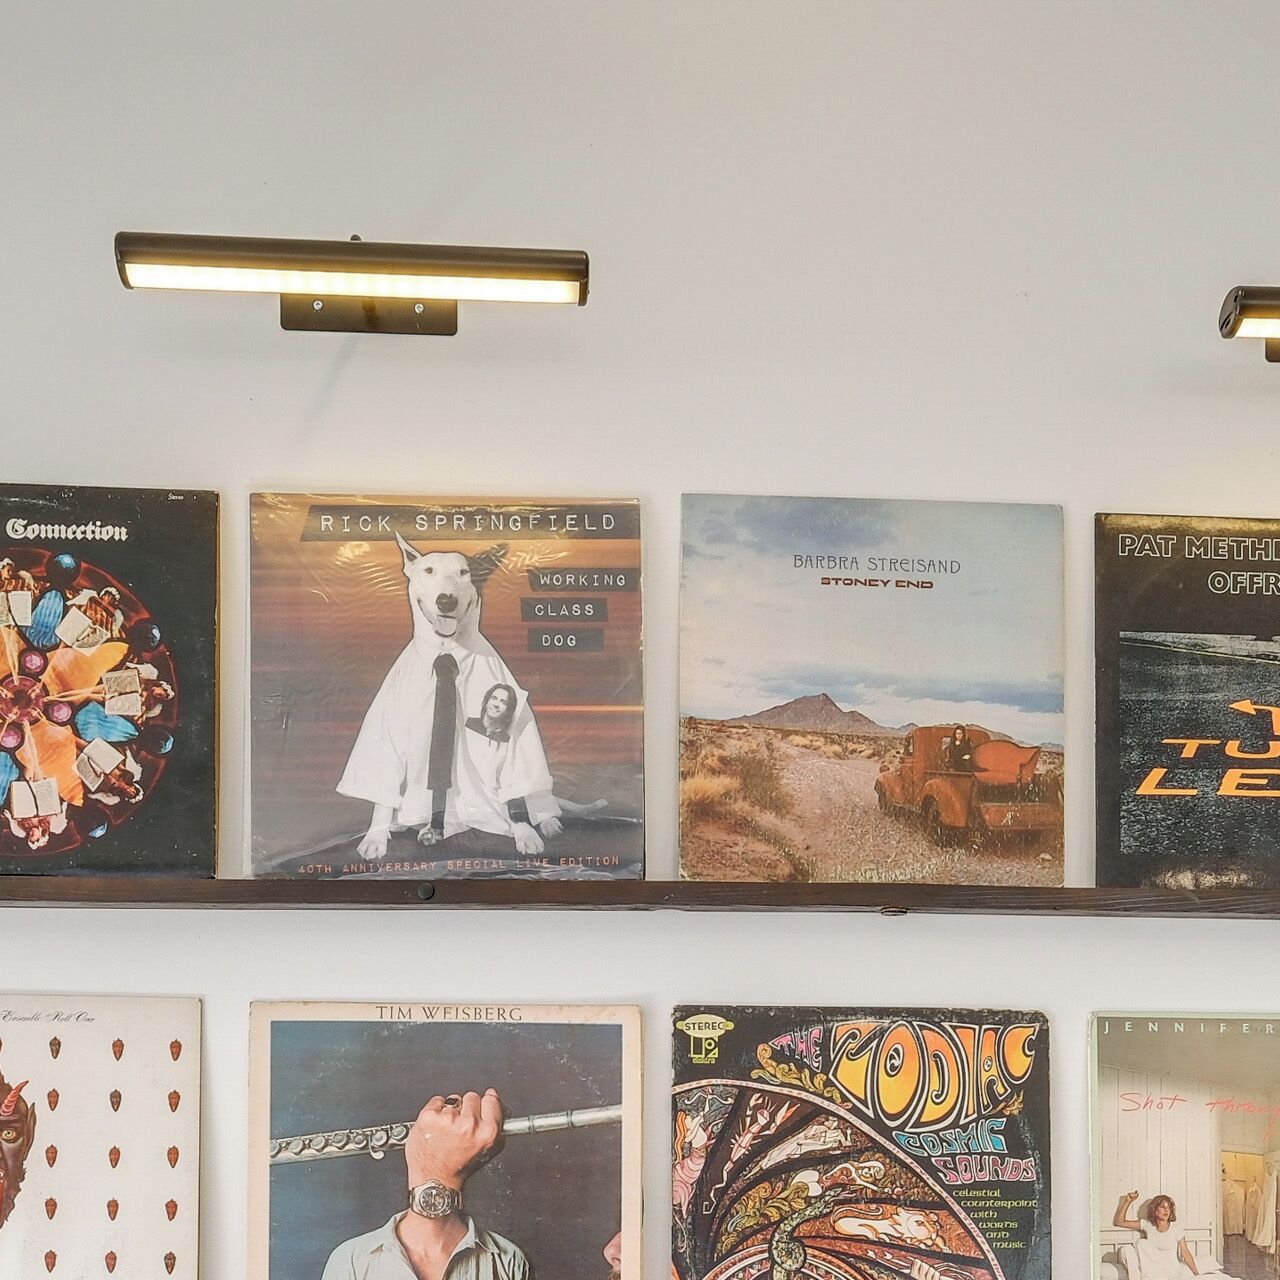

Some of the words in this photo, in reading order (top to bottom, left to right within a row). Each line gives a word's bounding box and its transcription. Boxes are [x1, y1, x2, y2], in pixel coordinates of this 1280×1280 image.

[5, 517, 128, 542] Connection
[320, 515, 392, 532] RICK
[415, 514, 616, 532] SPRINGFIELD
[1118, 533, 1176, 558] PAT
[793, 554, 859, 571] BARBRA
[867, 557, 961, 575] STREISAND
[539, 573, 627, 587] WORKING
[820, 576, 891, 588] STONEY
[895, 579, 934, 590] END
[534, 603, 595, 617] CLASS
[541, 634, 577, 647] DOG
[0, 1009, 43, 1023] Ensemble
[376, 1005, 413, 1020] TIM
[421, 1007, 523, 1022] WEISBERG
[1103, 1021, 1276, 1036] JENNIFER
[769, 1026, 823, 1072] THE
[828, 1019, 1040, 1132] ZODIAC
[1120, 1092, 1187, 1112] Shot
[892, 1117, 1008, 1156] COSMIC
[931, 1156, 1037, 1185] SOUNDS
[953, 1188, 1001, 1197] celestial
[970, 1210, 997, 1218] with
[979, 1221, 1018, 1229] words
[986, 1231, 1009, 1239] and
[992, 1241, 1027, 1249] music
